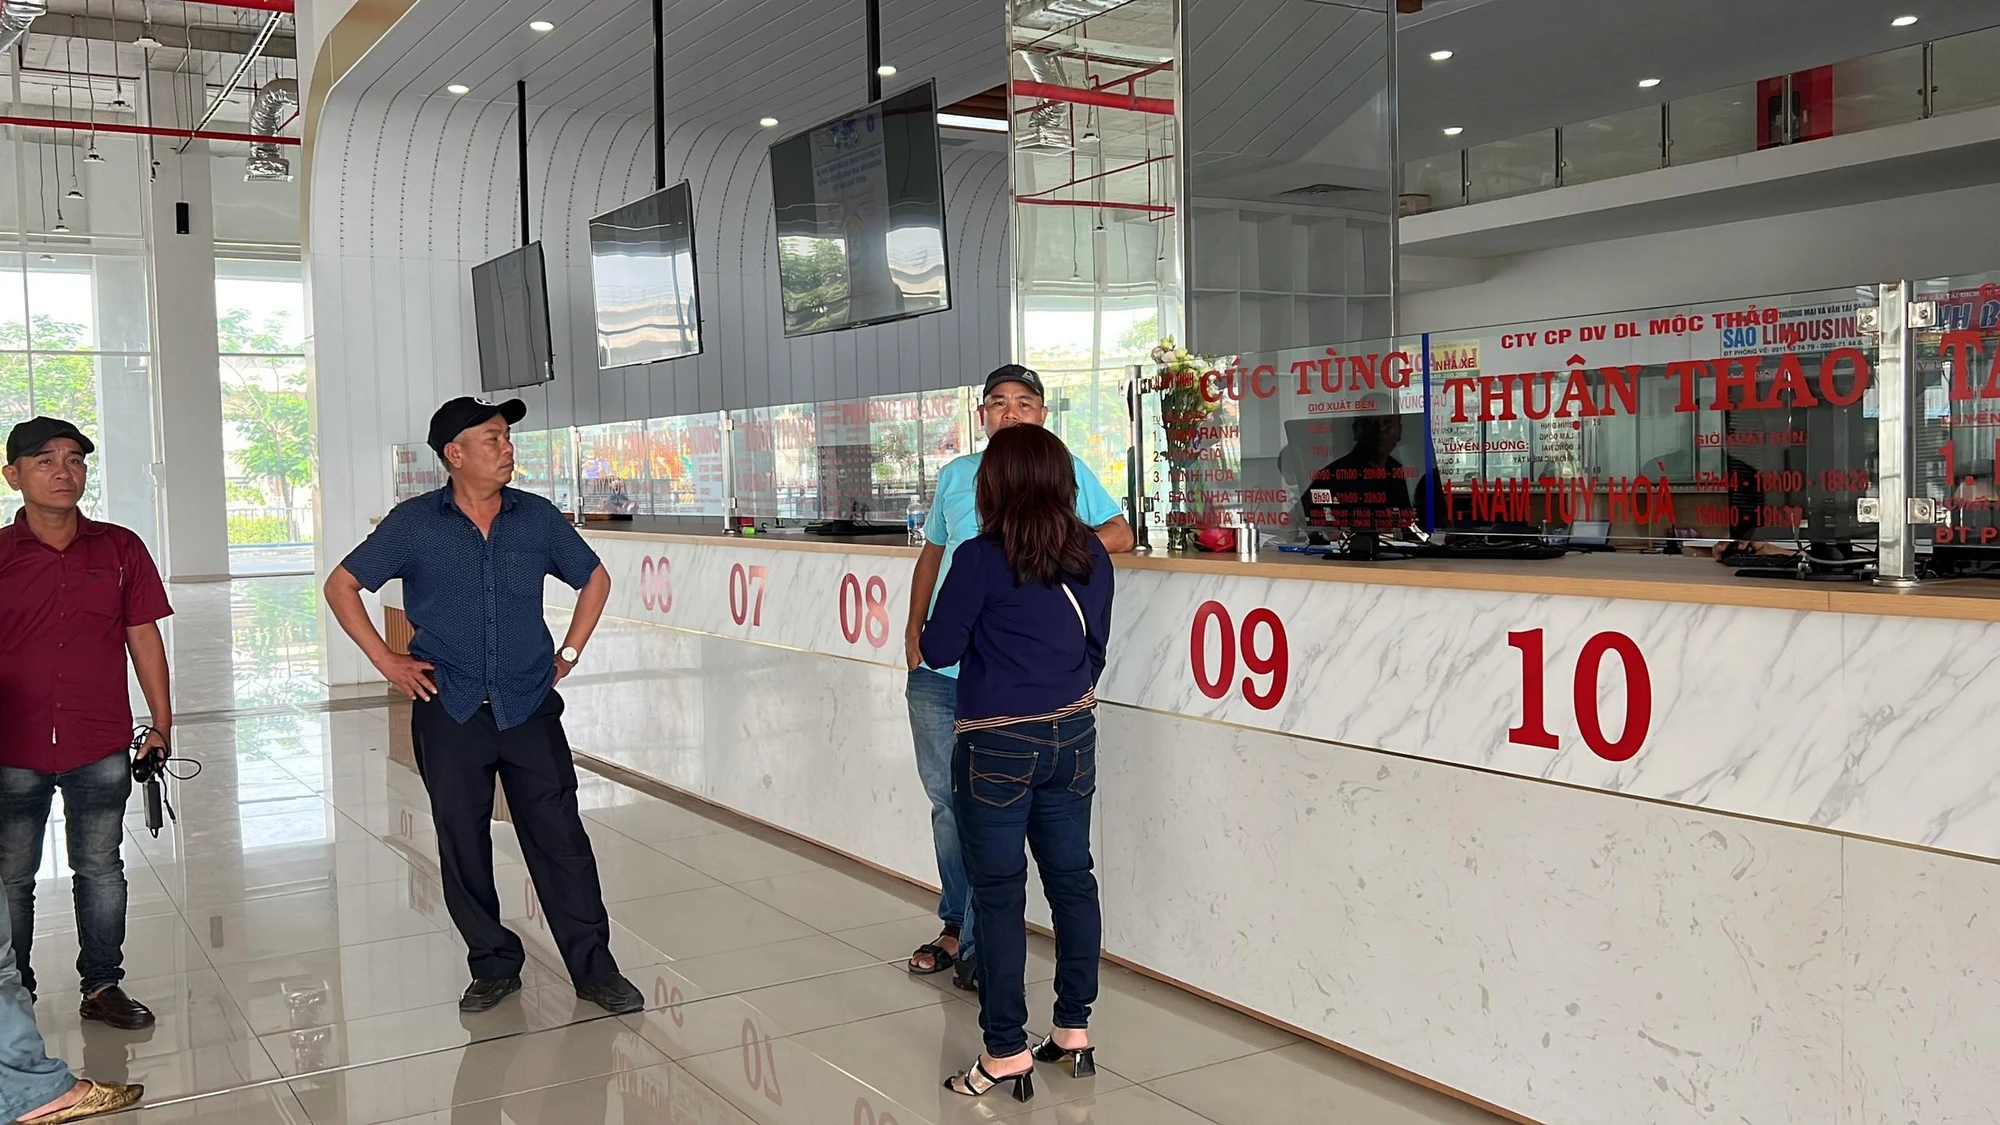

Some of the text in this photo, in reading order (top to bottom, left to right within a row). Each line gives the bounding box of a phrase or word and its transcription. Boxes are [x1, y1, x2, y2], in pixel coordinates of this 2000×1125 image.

[1501, 304, 1779, 349] CTY CP DV DL MỘC THẢO
[1723, 327, 1757, 349] SAO
[1200, 356, 1277, 403] CÚC
[1290, 347, 1413, 396] TÙNG
[1442, 327, 1870, 431] THUẬN THẢO
[1460, 357, 1475, 370] XE
[1199, 425, 1239, 440] RANH
[1443, 437, 1480, 453] TUYẾN
[1484, 438, 1530, 452] ĐƯỜNG:
[1199, 490, 1232, 504] NHA
[1236, 510, 1292, 526] TRANG
[1443, 461, 1676, 526] 1. NAM TUY HOÀ
[641, 555, 673, 613] 06
[729, 562, 767, 626] 07
[839, 572, 890, 648] 08
[1190, 600, 1289, 711] 09
[1507, 627, 1653, 762] 10
